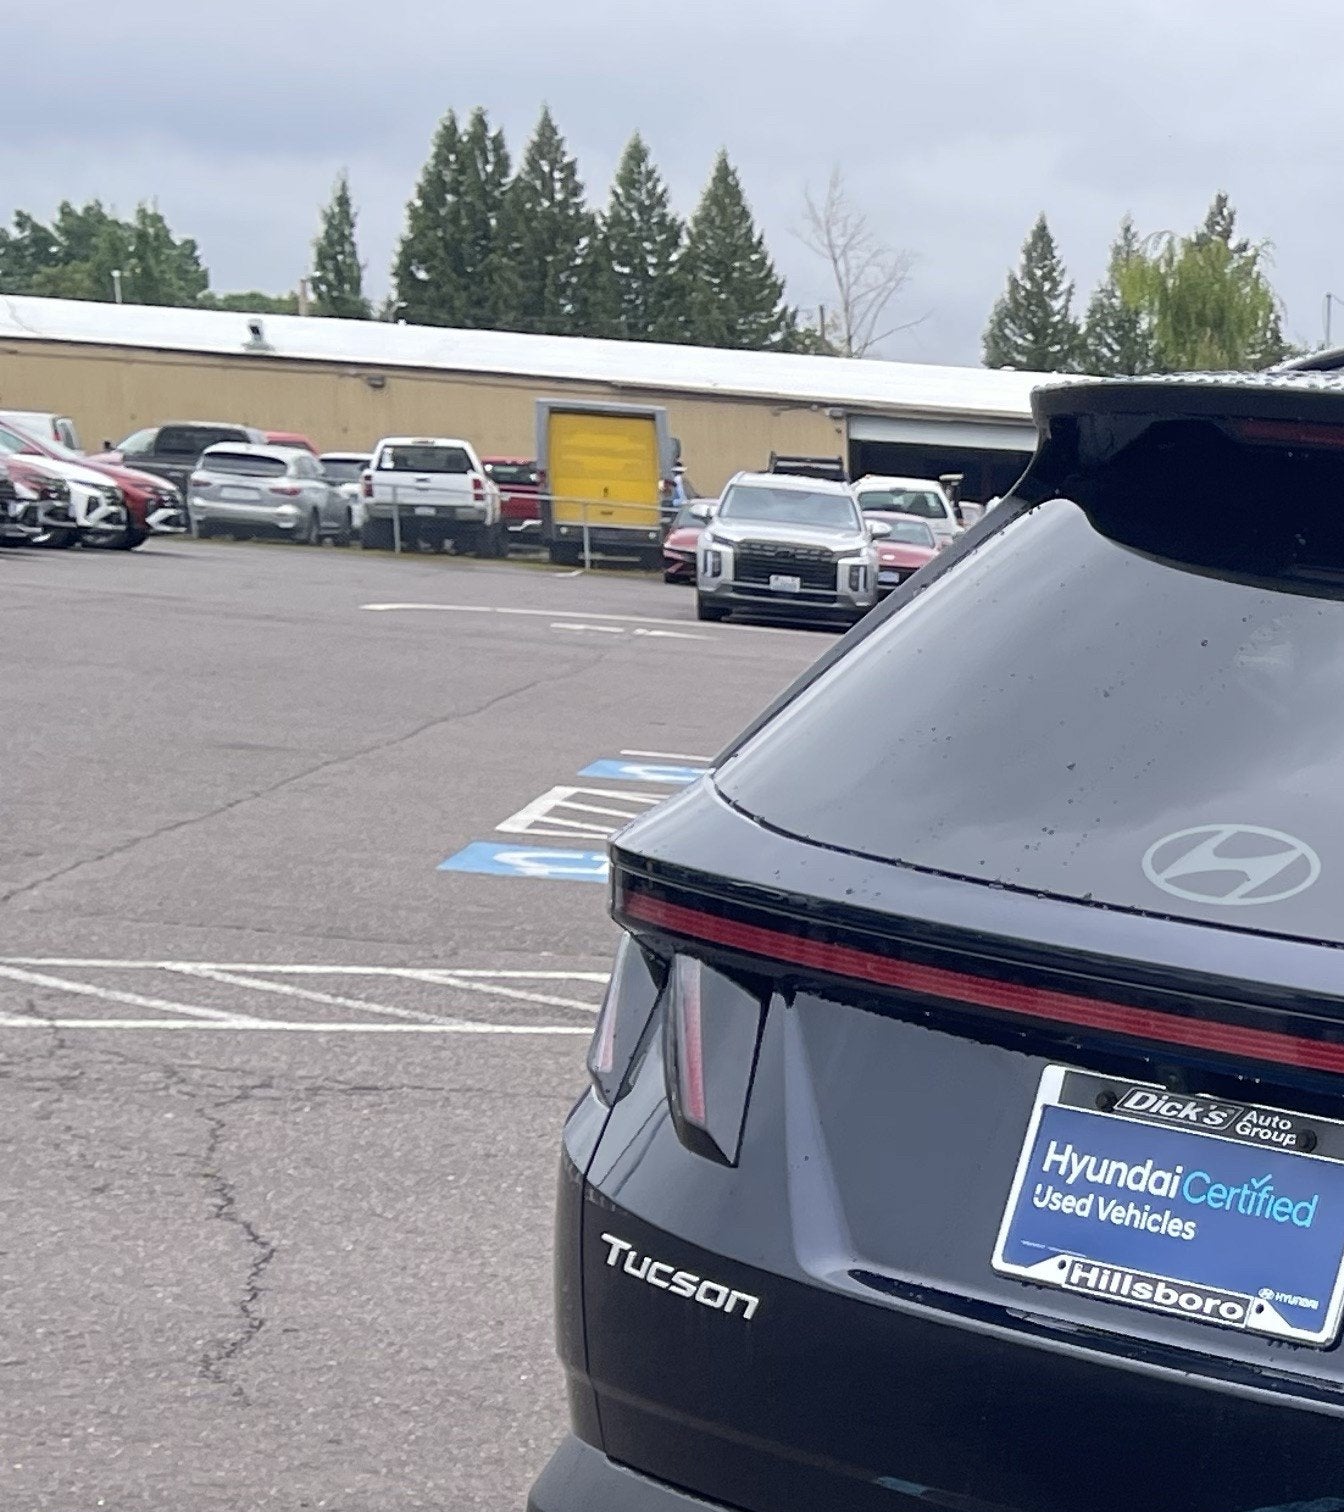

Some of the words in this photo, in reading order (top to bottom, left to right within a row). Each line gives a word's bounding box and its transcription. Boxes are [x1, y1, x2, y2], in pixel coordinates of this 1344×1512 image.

[1124, 1091, 1228, 1126] Dick's
[1245, 1110, 1292, 1130] Auto
[1235, 1121, 1297, 1147] Group
[1042, 1140, 1184, 1199] Hyundai
[1182, 1171, 1320, 1228] Certified
[1032, 1183, 1095, 1218] Used
[1099, 1196, 1197, 1241] Vehicles
[1069, 1261, 1244, 1320] Hillsboro
[1275, 1292, 1319, 1310] HYUNDAI
